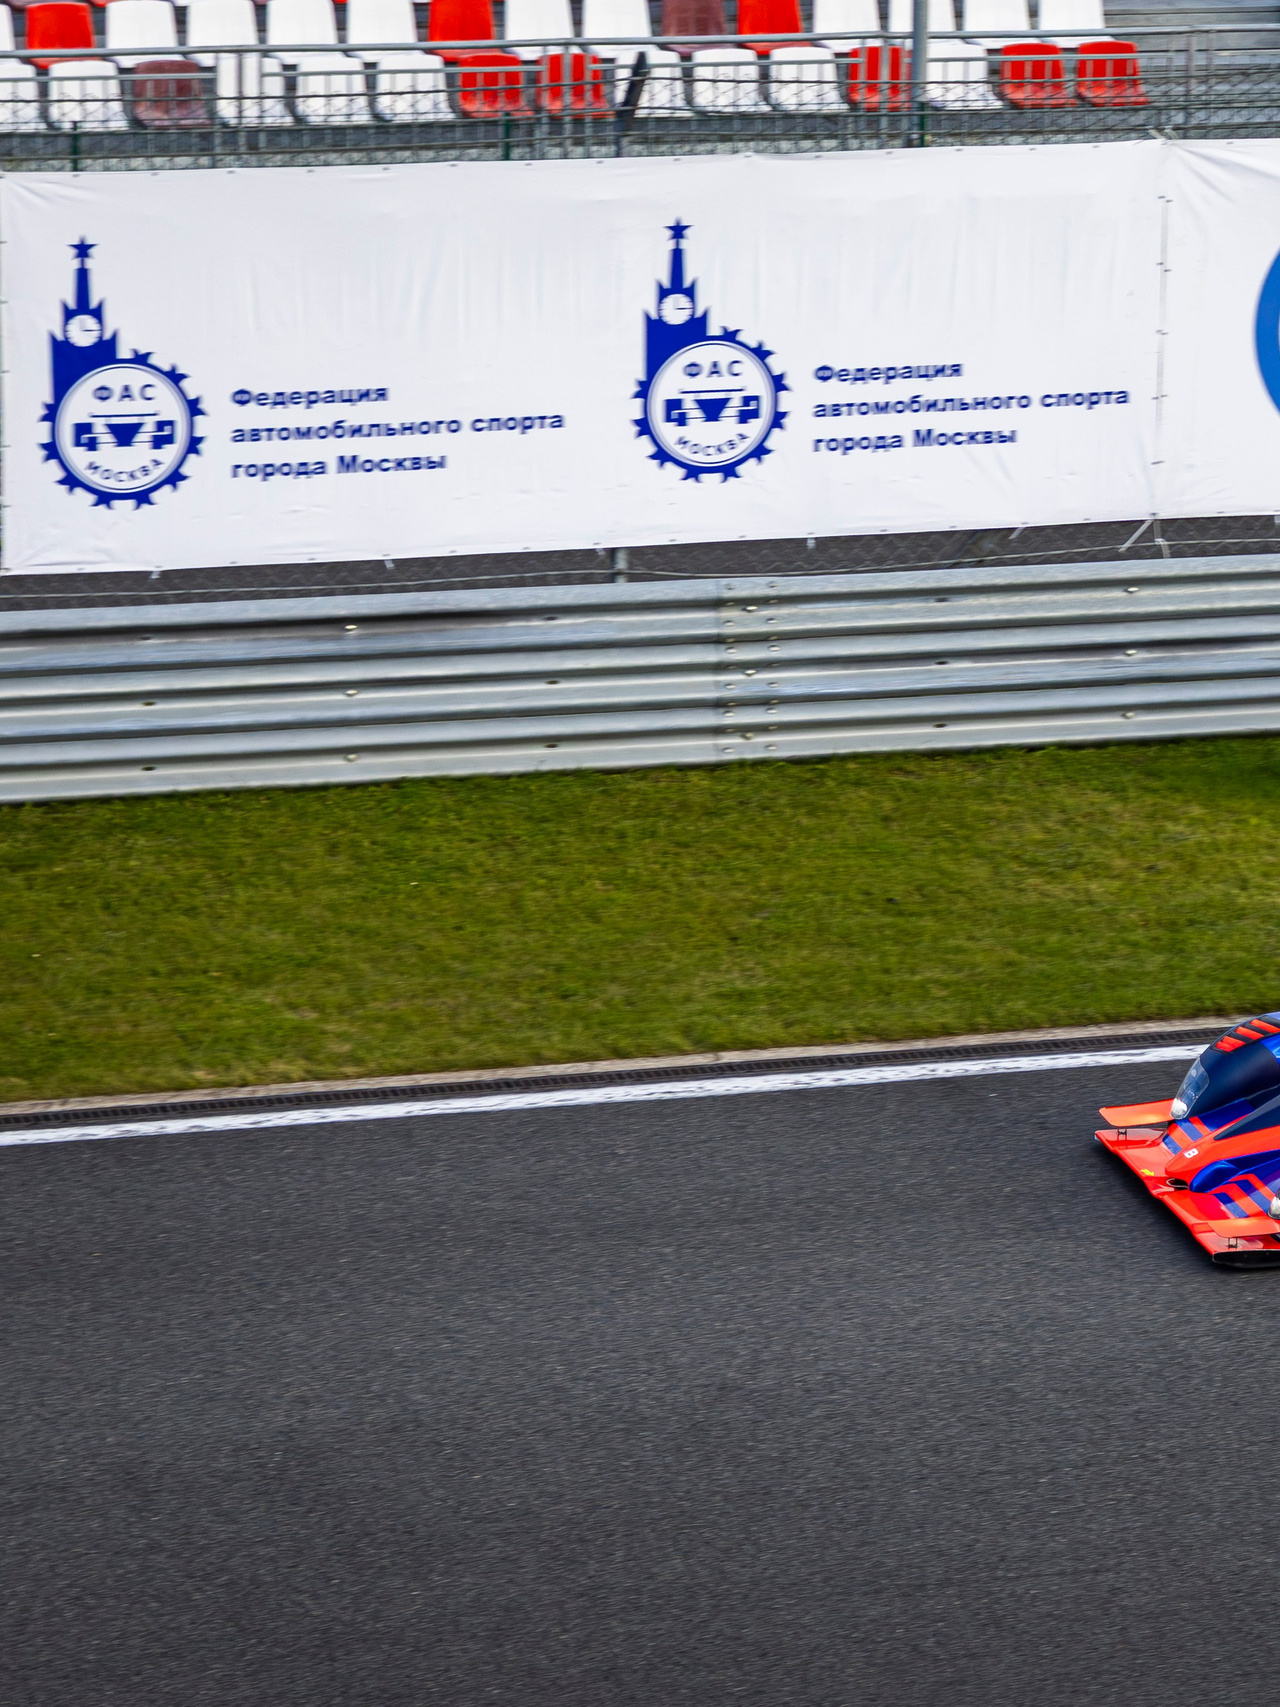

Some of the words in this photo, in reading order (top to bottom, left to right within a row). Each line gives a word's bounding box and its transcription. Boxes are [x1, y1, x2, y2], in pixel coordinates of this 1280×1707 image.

[685, 360, 742, 378] ФАС
[814, 362, 963, 384] Федерация
[94, 383, 155, 402] ФАС
[231, 386, 389, 409] Федерация
[813, 394, 1031, 419] автомобильного
[1041, 389, 1130, 411] спорта
[231, 419, 462, 444] автомобильного
[470, 413, 565, 435] спорта
[813, 434, 903, 455] города
[912, 427, 1017, 447] Москвы
[674, 432, 750, 457] МОСКВА
[85, 457, 164, 483] МОСКВА
[231, 459, 327, 481] города
[336, 453, 447, 474] Москвы
